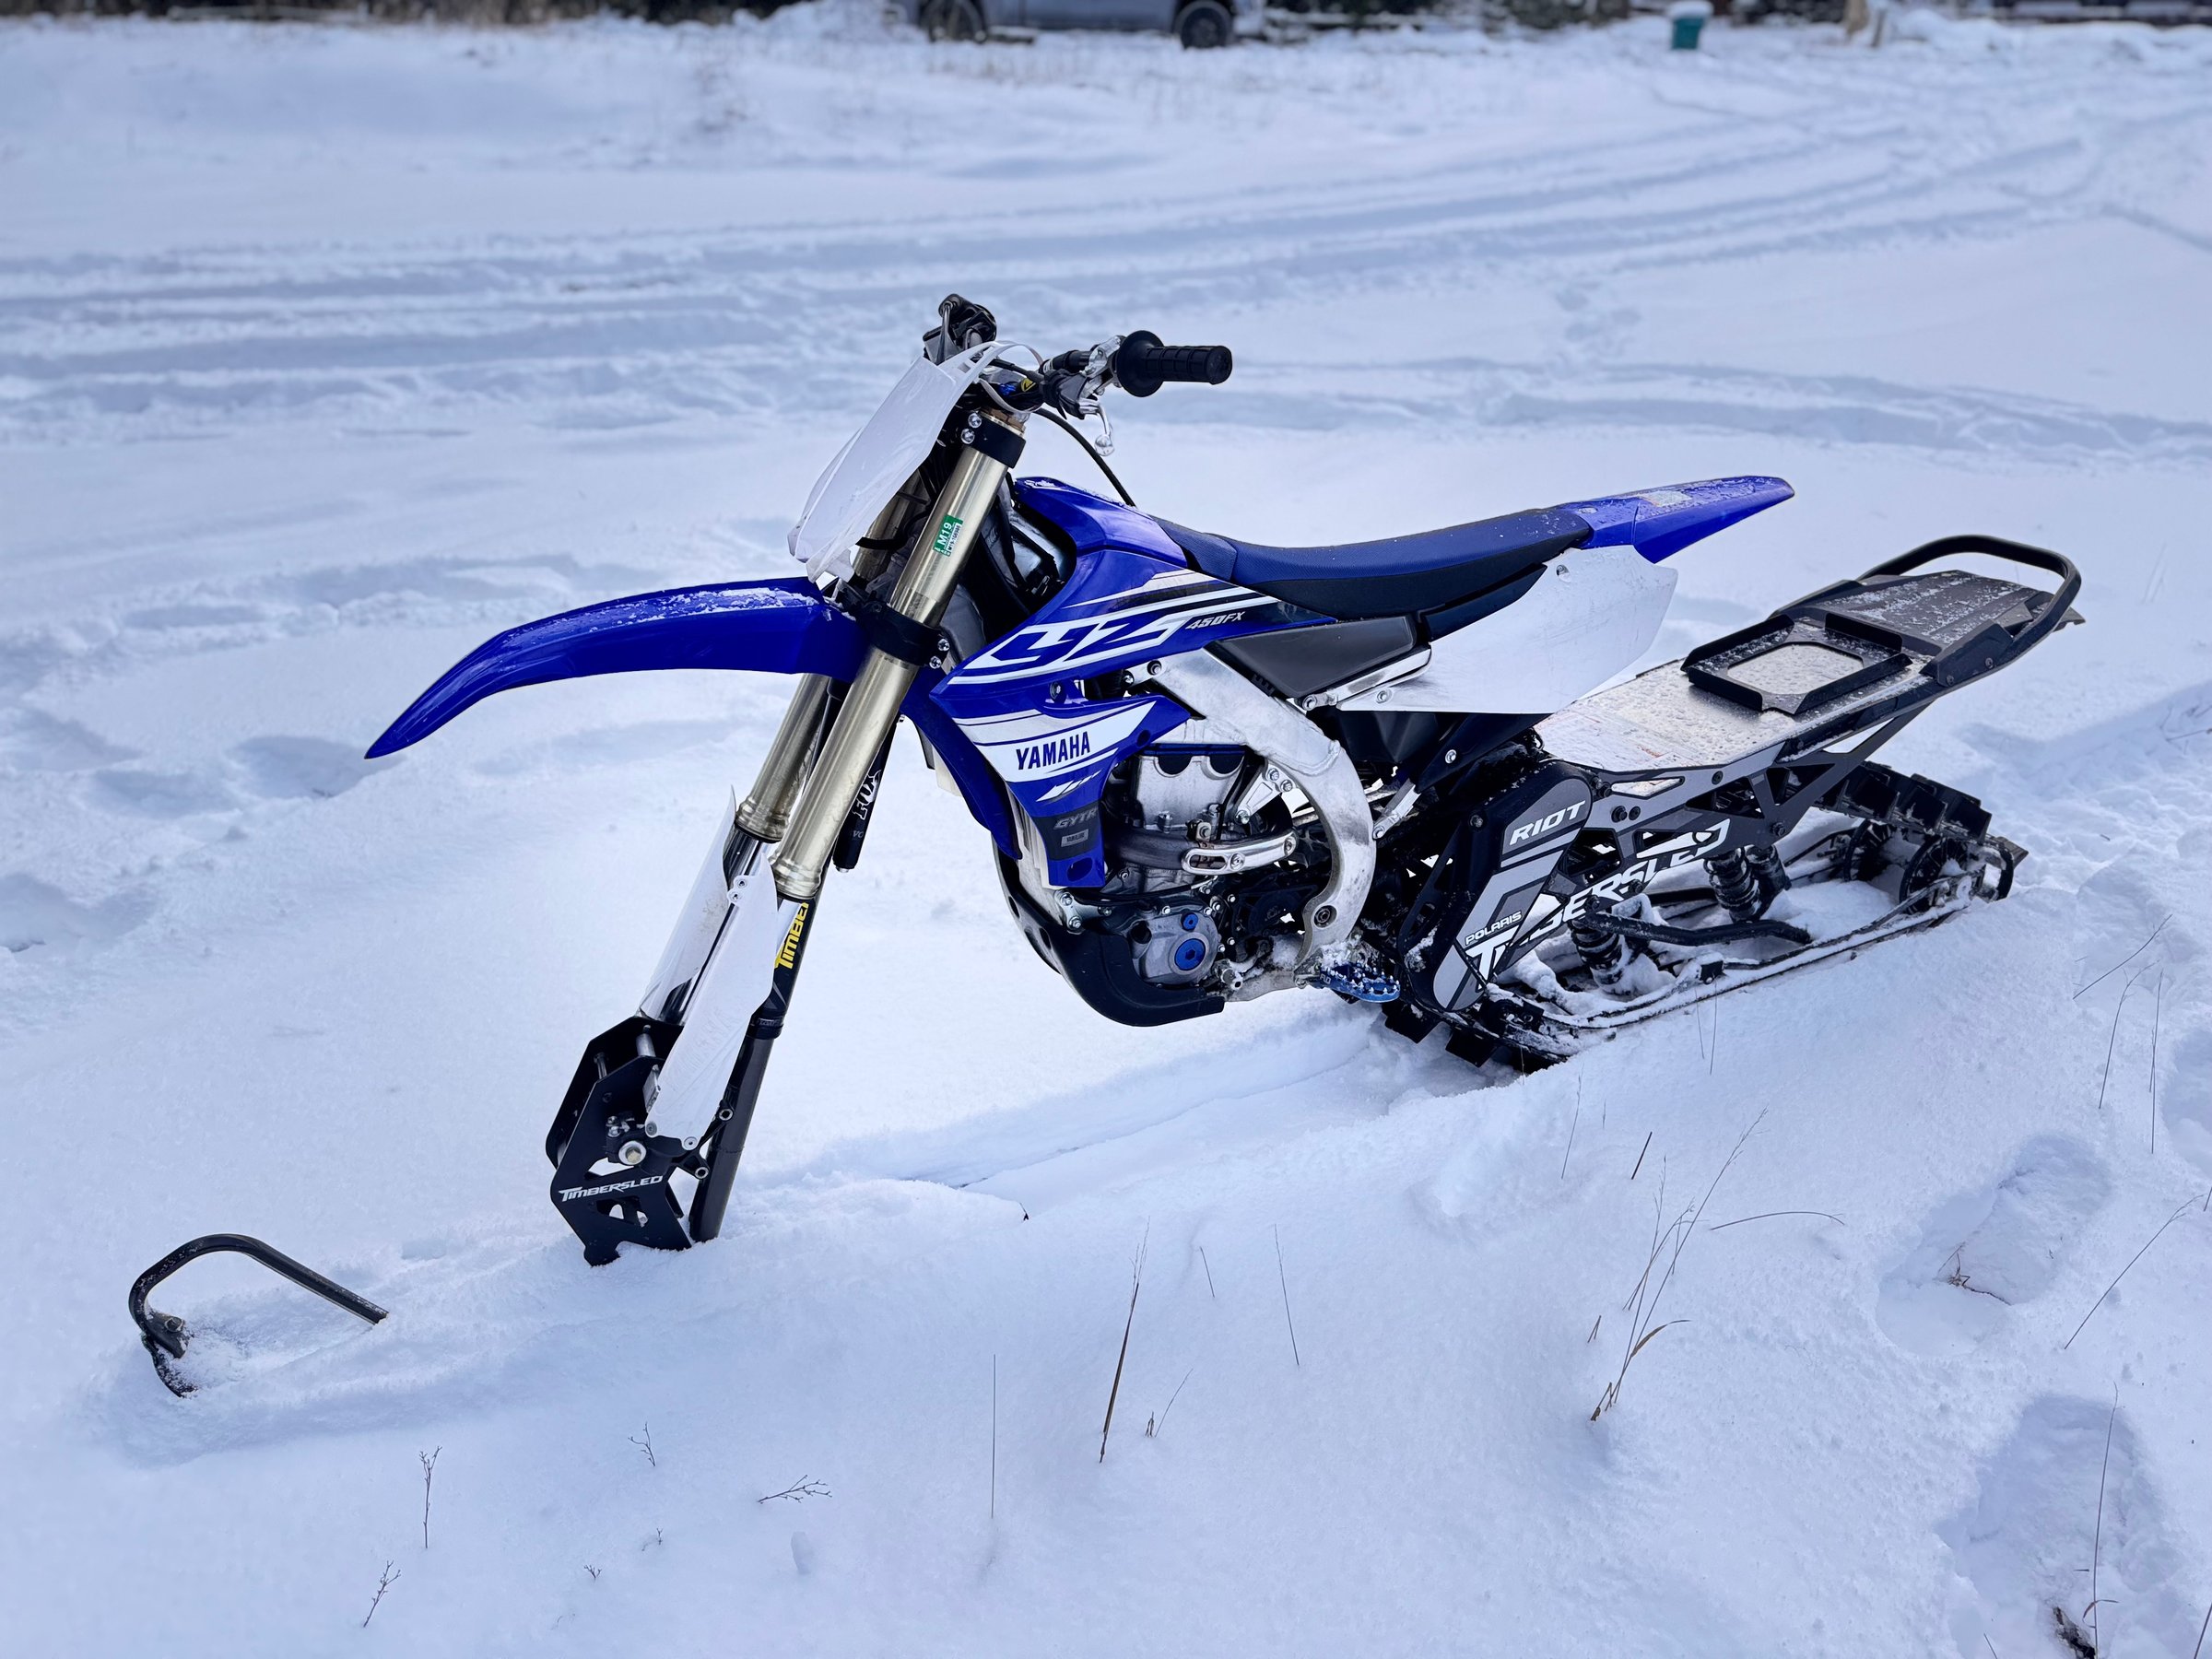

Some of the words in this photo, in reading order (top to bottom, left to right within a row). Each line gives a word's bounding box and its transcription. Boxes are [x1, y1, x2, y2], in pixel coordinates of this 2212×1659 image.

[937, 522, 952, 546] M19
[1184, 611, 1246, 629] 450FX
[1016, 731, 1090, 771] YAMAHA
[1053, 806, 1099, 830] GYTR
[1509, 800, 1586, 846] RIOT
[1465, 911, 1523, 946] POLARIS
